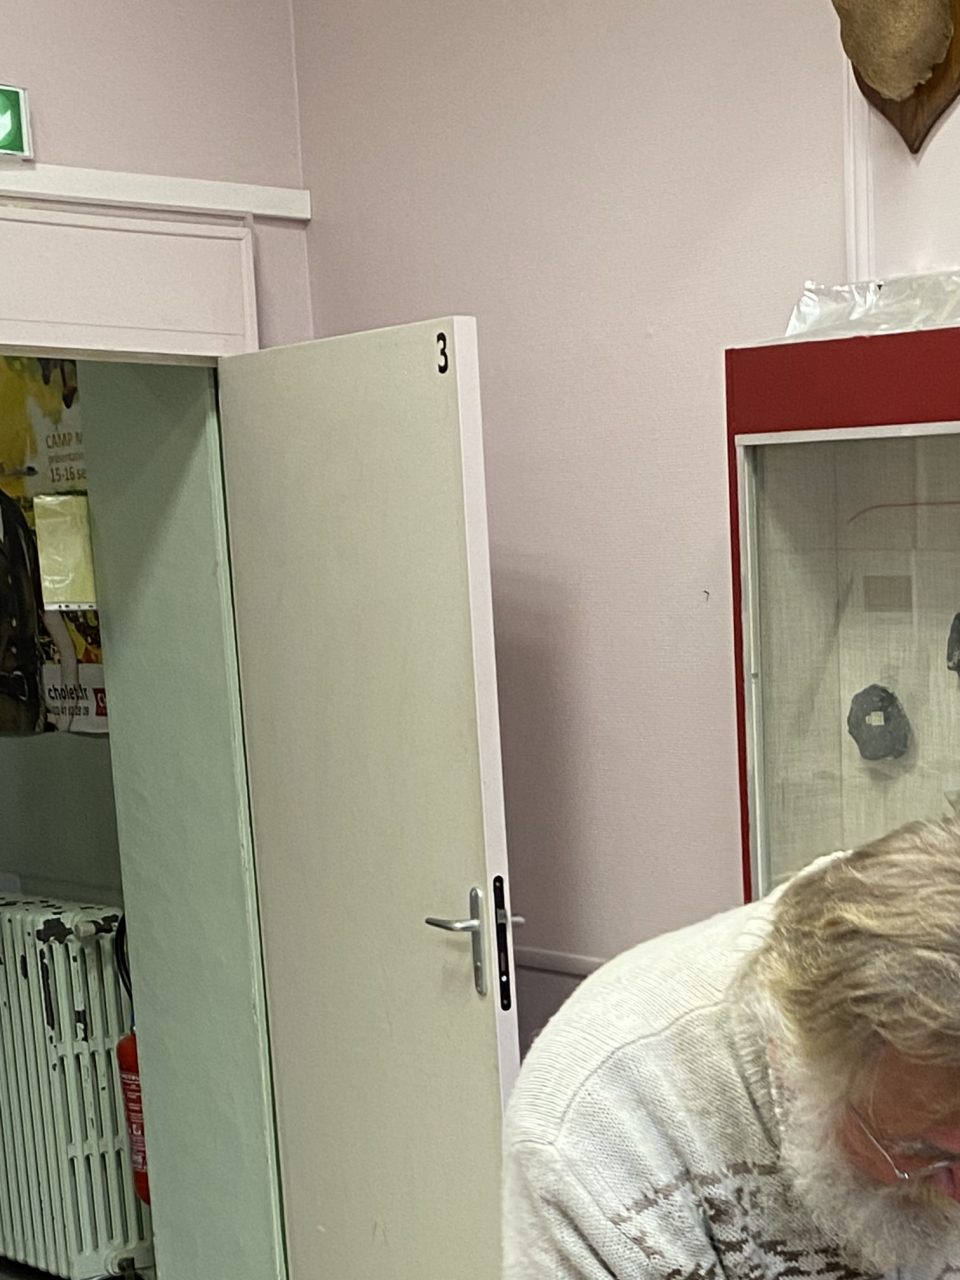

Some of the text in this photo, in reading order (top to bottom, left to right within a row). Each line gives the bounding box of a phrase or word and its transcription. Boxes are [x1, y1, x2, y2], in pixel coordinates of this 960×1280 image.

[436, 332, 449, 374] 3
[45, 431, 73, 449] CAMP
[50, 465, 76, 483] 15-16
